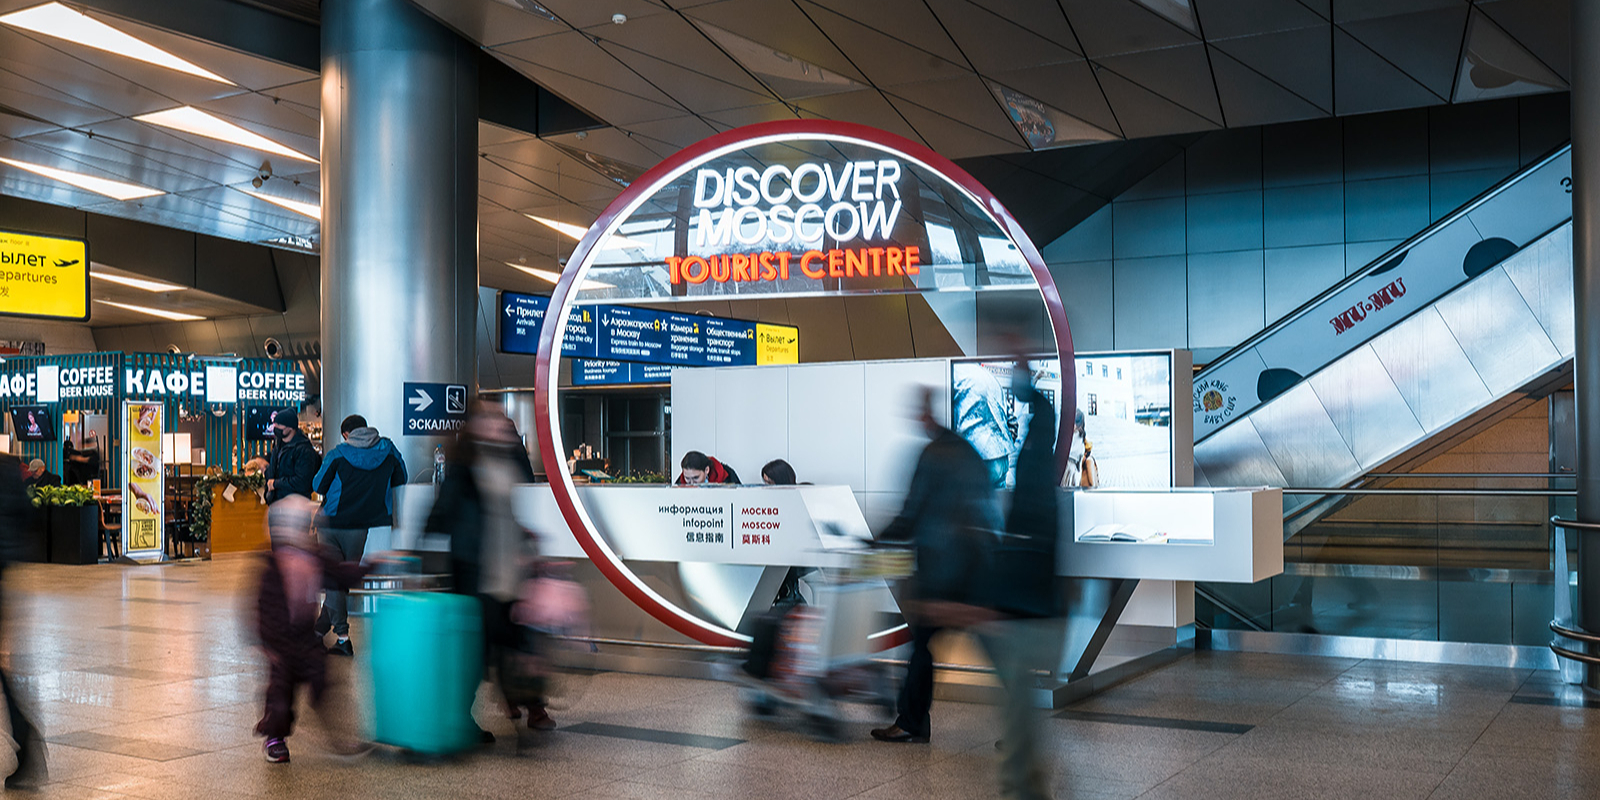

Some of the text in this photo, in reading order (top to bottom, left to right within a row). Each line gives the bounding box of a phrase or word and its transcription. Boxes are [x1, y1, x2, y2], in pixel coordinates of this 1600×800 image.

[693, 159, 901, 208] DISCOVER
[696, 200, 902, 247] MOSCOW
[1, 251, 47, 267] ылет
[665, 246, 920, 285] TOURIST CENTRE
[0, 270, 58, 284] epartures
[517, 306, 544, 318] Прилет
[516, 318, 535, 327] Arrivals
[568, 314, 583, 323] ход
[611, 317, 654, 330] Аэроэкспресс
[616, 328, 640, 340] Москву
[671, 323, 693, 335] Камера
[706, 327, 748, 339] Общественный
[671, 334, 698, 344] хранения
[706, 338, 735, 348] транспорт
[766, 333, 785, 344] Вылет
[584, 360, 605, 368] Priority
[60, 366, 113, 386] COFFEE
[125, 369, 204, 395] КАФЕ
[238, 371, 305, 389] COFFEE
[0, 373, 36, 397] АФЕ
[60, 385, 113, 397] BEER HOUSE
[238, 389, 305, 401] BEER HOUSE
[1204, 413, 1224, 424] BABY
[658, 504, 723, 515] информация
[682, 518, 724, 529] infopoint
[686, 532, 724, 543] 信息指南
[742, 534, 771, 545] 莫斯科
